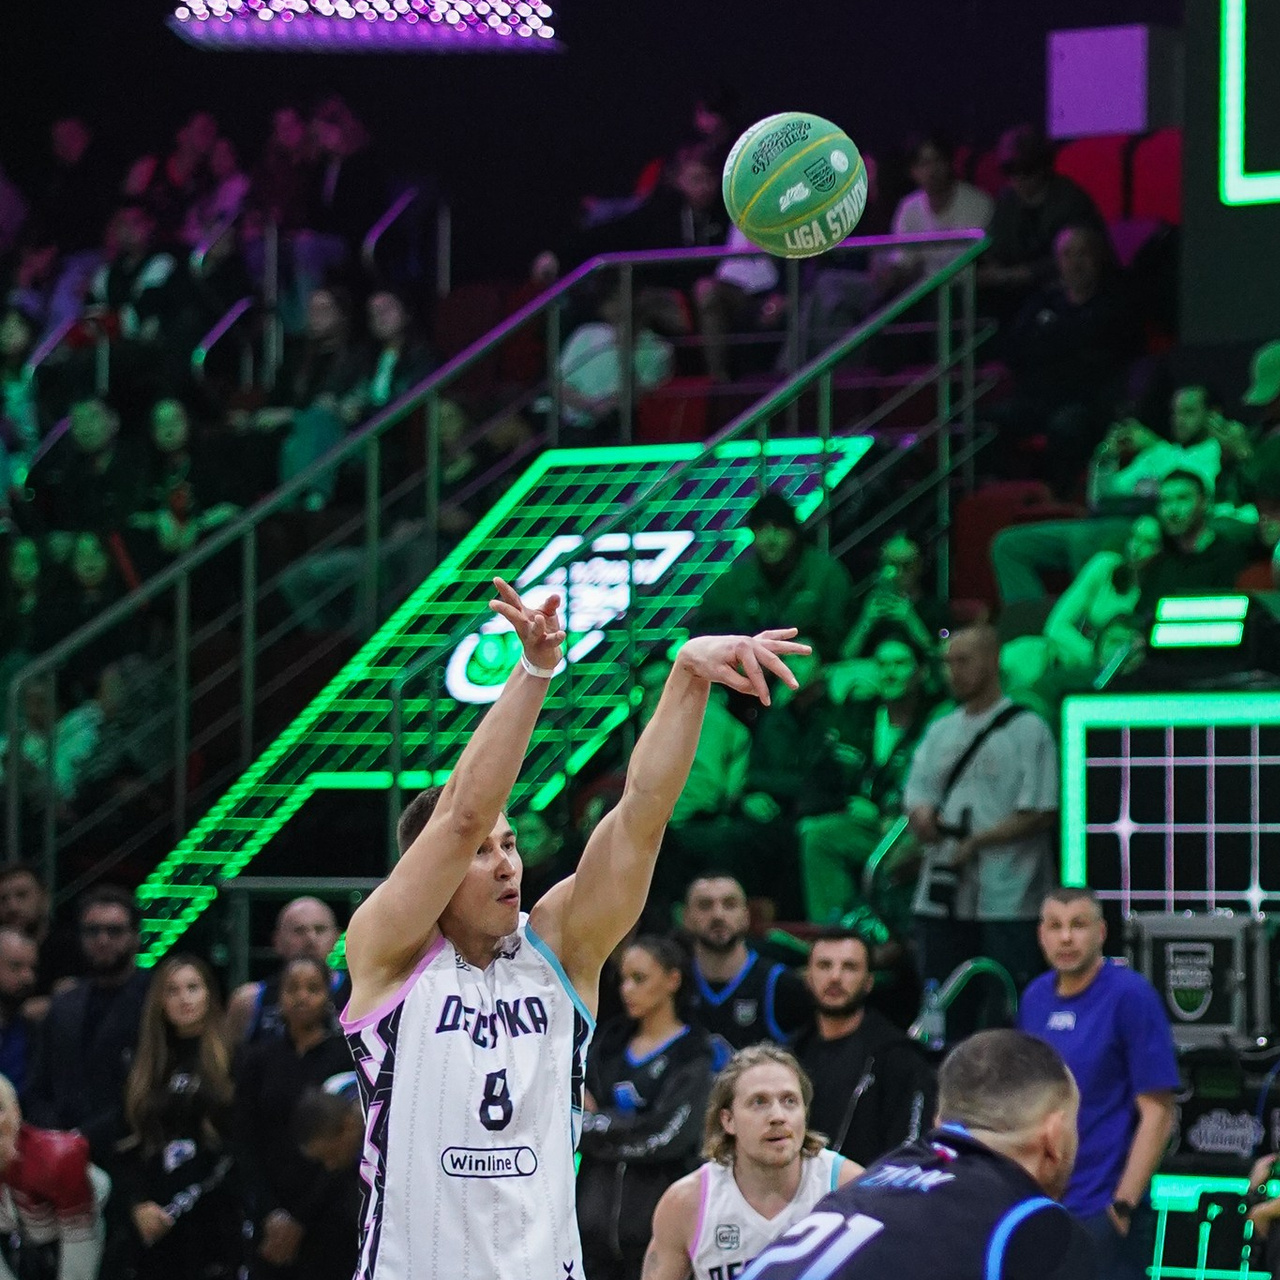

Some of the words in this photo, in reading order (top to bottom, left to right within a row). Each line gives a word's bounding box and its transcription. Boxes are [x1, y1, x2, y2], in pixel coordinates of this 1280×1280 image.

[785, 220, 828, 250] LIGA
[479, 1068, 513, 1131] 8
[450, 1153, 512, 1171] Winline
